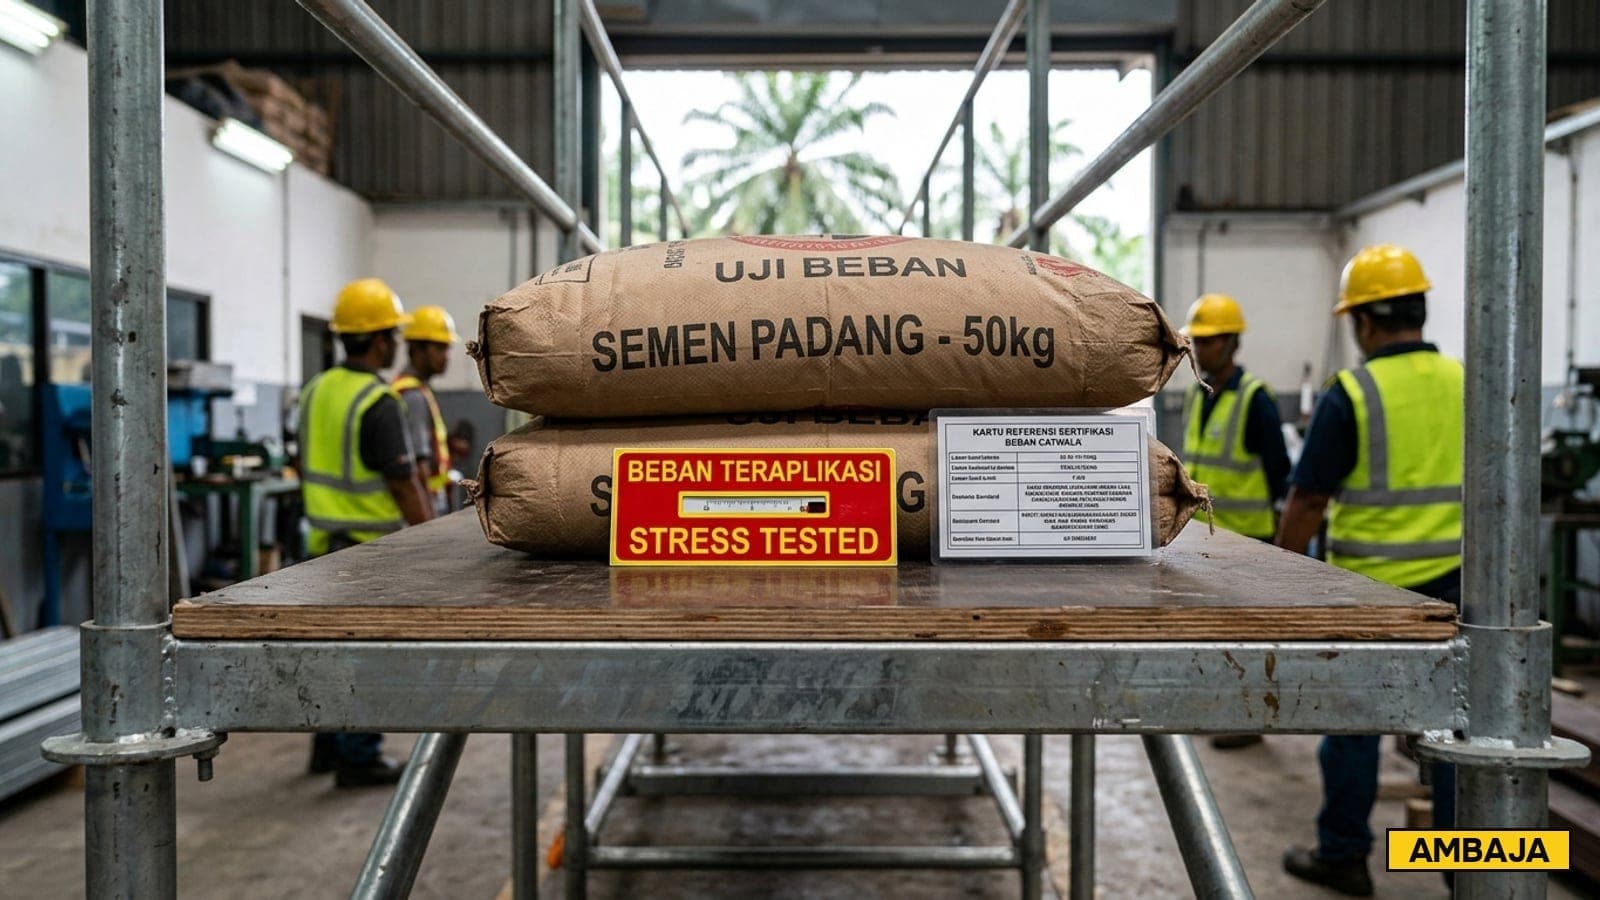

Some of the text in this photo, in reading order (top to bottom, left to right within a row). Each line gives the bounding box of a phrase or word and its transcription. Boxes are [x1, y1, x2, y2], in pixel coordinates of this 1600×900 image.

[715, 256, 967, 283] UJI BEBAN
[592, 314, 1055, 373] SEMEN PADANG - 50kg
[972, 427, 1114, 436] KARTU REFERENSI SERTIFIKASI
[1005, 438, 1082, 446] BEBAN CATWALA
[627, 460, 881, 482] BEBAN TERAPLIKASI
[629, 526, 879, 555] STRESS TESTED
